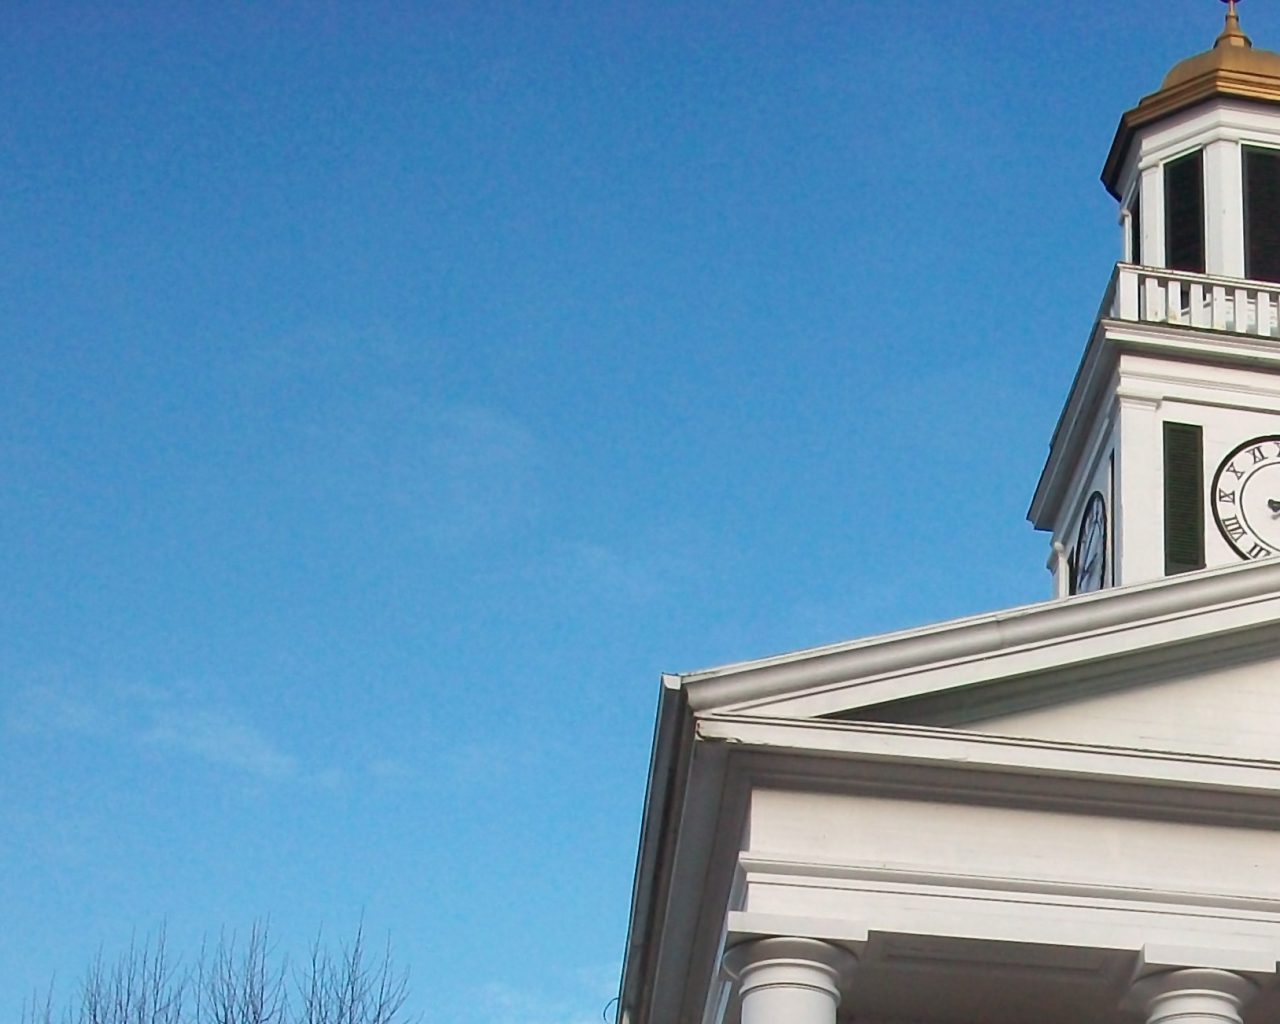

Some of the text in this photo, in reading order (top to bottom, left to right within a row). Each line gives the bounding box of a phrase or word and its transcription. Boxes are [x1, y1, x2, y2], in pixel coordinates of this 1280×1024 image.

[1245, 445, 1269, 462] XI
[1225, 460, 1245, 480] X
[1218, 487, 1236, 504] IX
[1221, 514, 1248, 542] VIII
